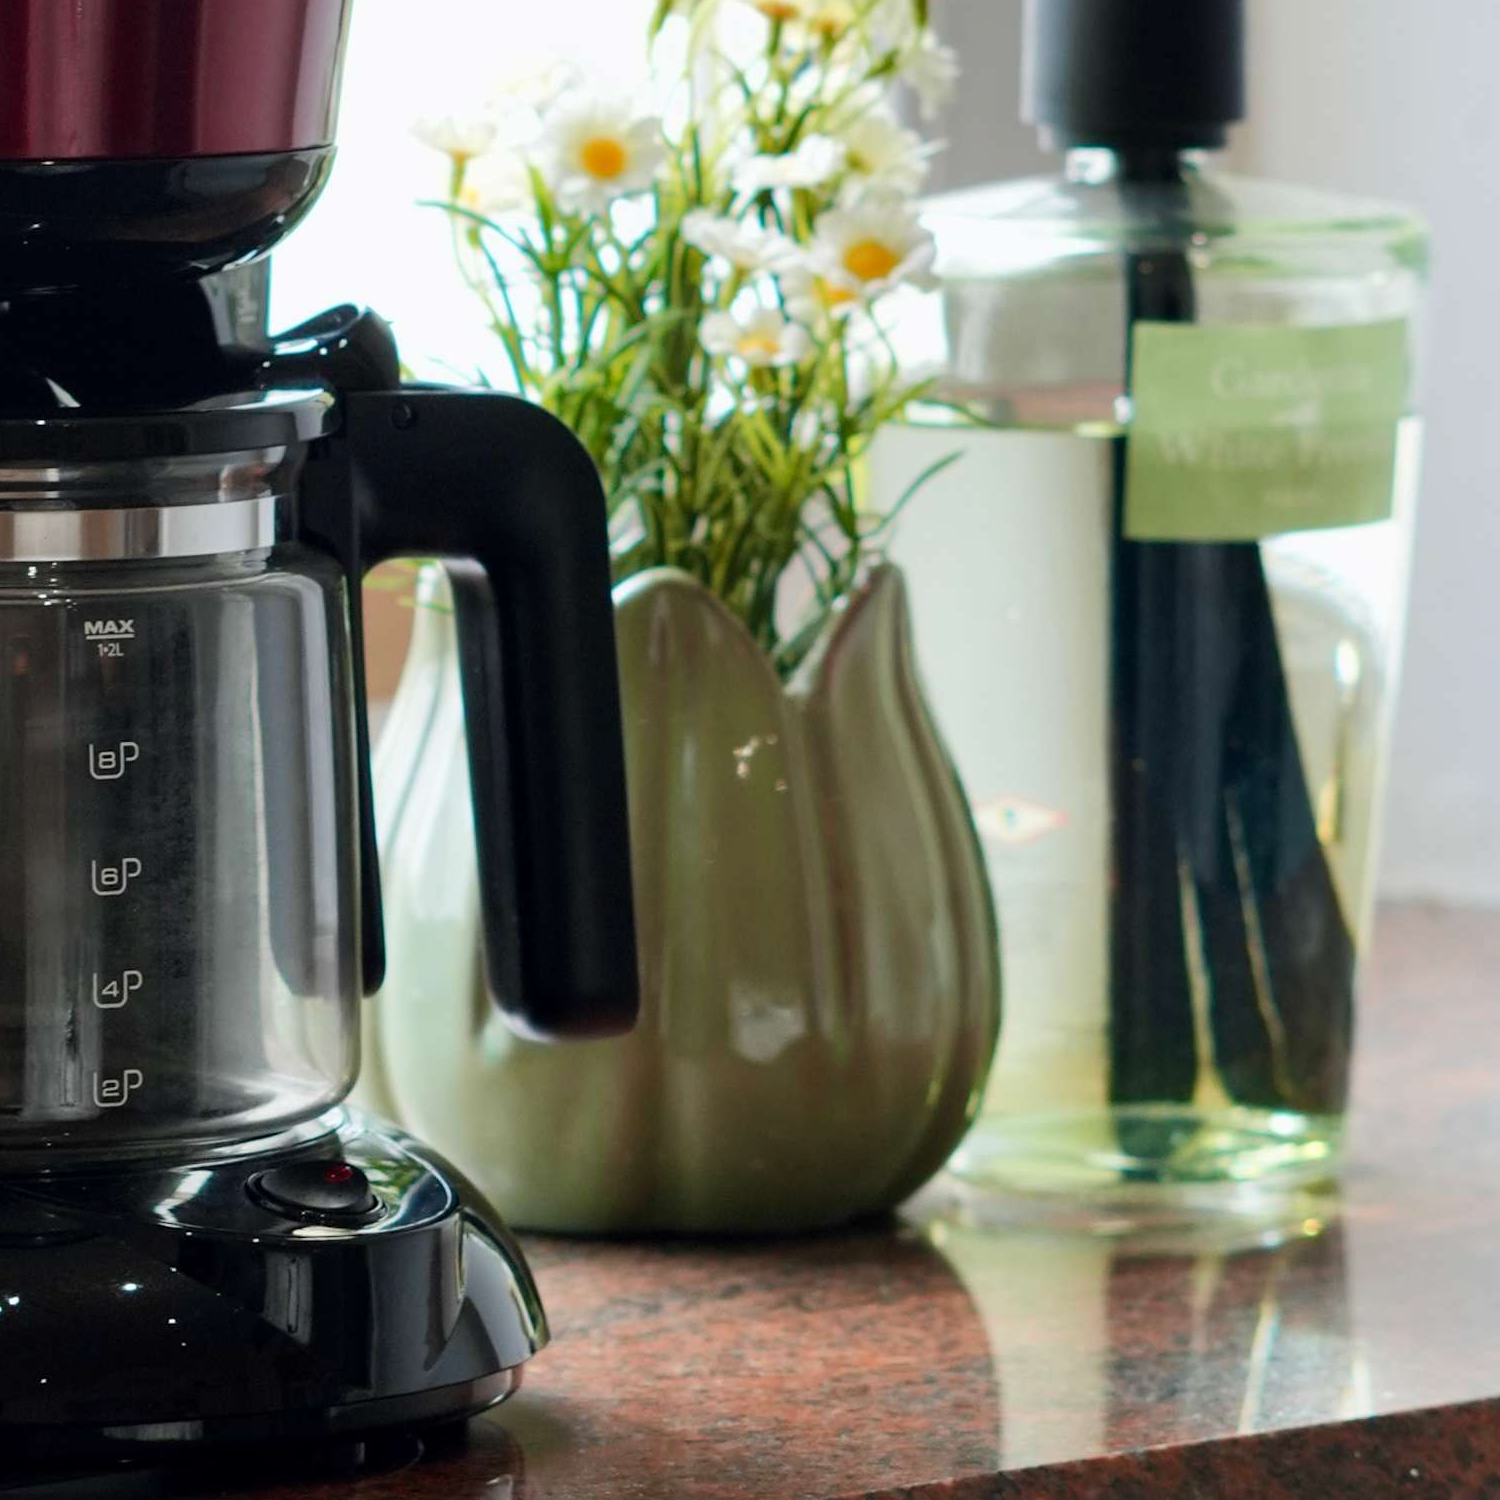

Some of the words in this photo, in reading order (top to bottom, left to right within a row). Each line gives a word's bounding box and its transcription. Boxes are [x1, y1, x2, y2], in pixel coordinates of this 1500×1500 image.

[84, 619, 135, 635] MAX
[97, 750, 117, 769] 8
[101, 867, 119, 886] 6
[101, 979, 120, 998] 4
[101, 1078, 120, 1097] 2
